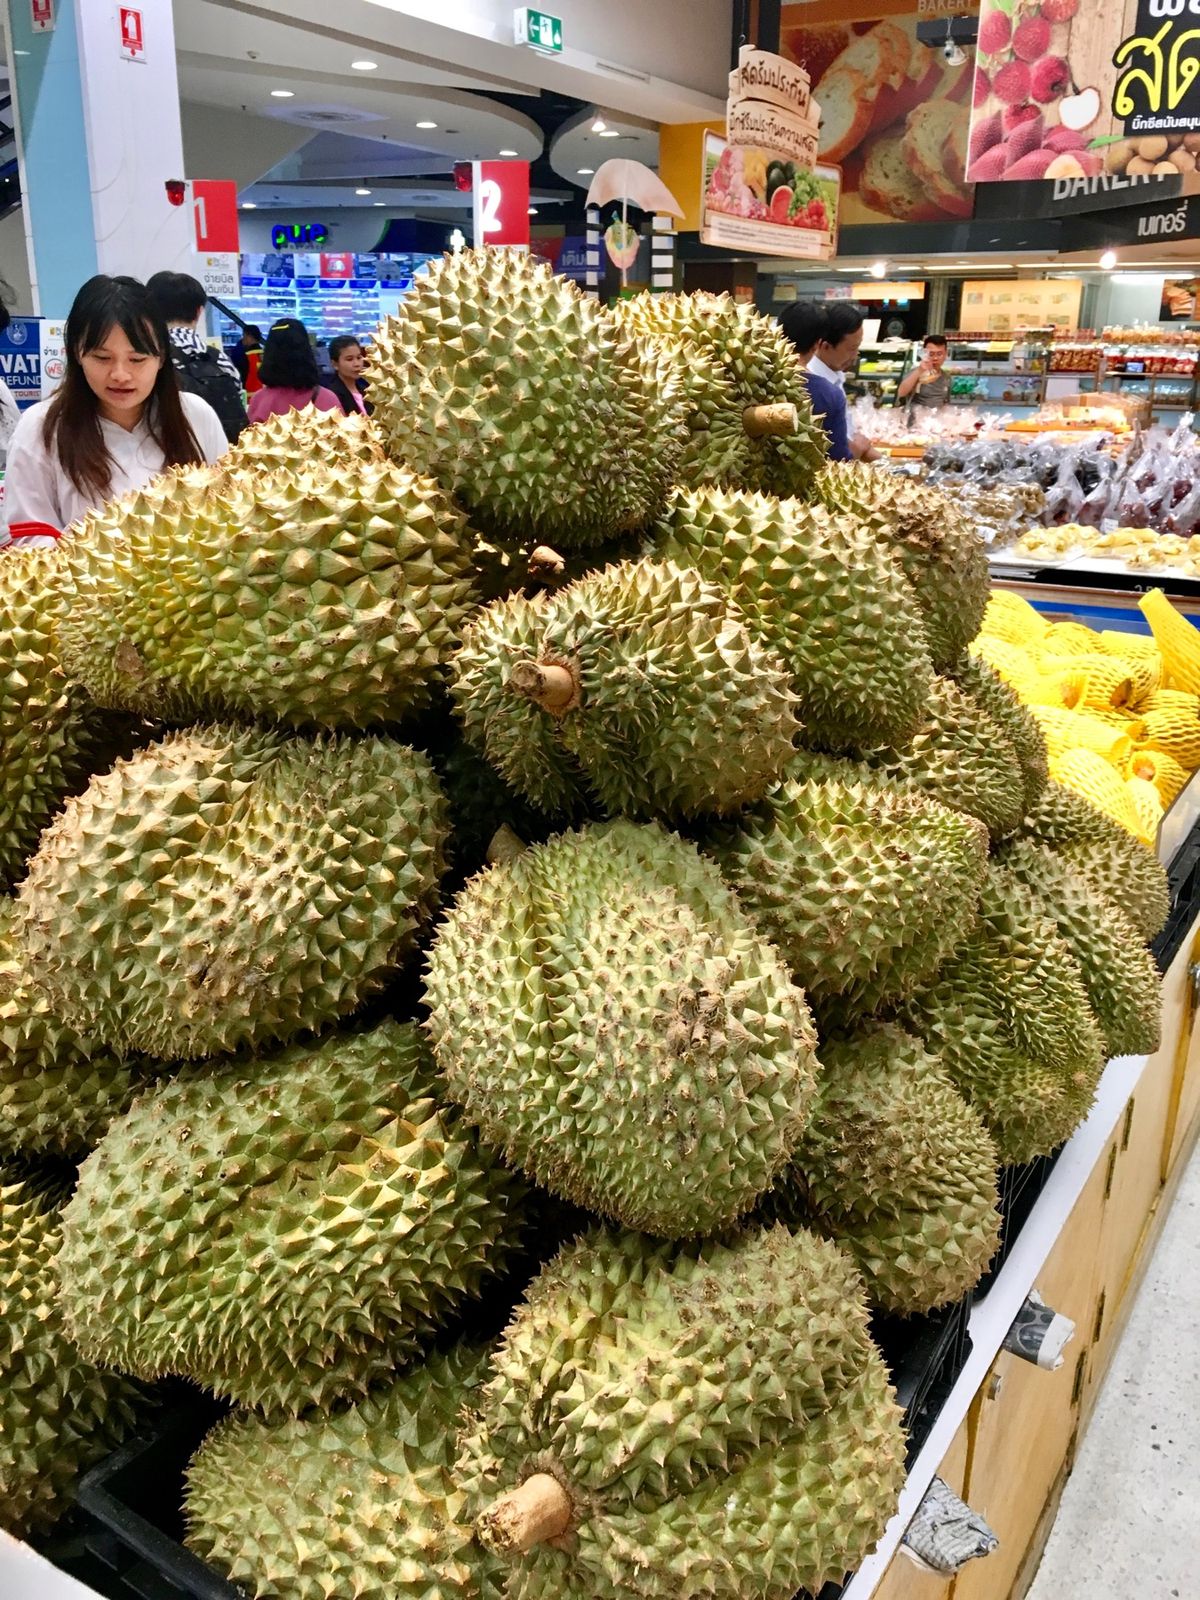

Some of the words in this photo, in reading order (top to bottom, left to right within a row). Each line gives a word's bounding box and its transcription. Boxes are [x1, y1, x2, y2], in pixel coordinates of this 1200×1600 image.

[194, 197, 208, 239] 1
[479, 179, 503, 232] 2
[1137, 199, 1189, 237] เบเกอรี่
[272, 223, 328, 250] pure
[0, 354, 40, 374] VAT
